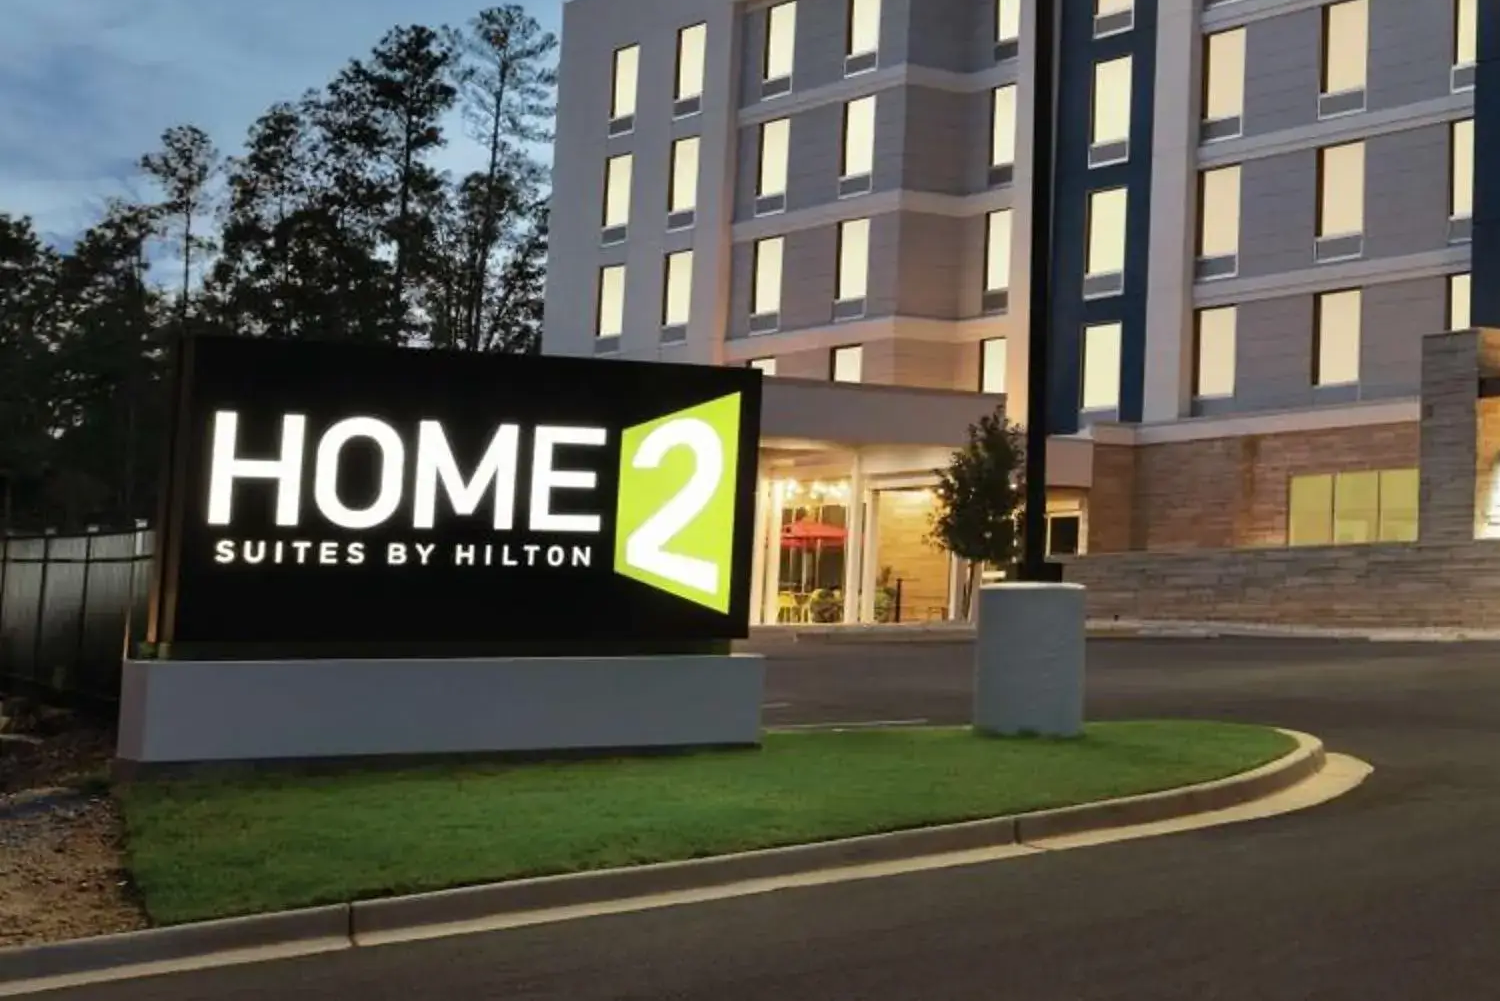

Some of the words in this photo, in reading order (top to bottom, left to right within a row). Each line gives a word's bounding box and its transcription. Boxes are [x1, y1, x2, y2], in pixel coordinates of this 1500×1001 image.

[207, 410, 607, 532] HOME
[626, 418, 724, 594] 2
[214, 539, 366, 565] SUITES
[387, 543, 436, 566] BY
[455, 544, 593, 567] HILTON
